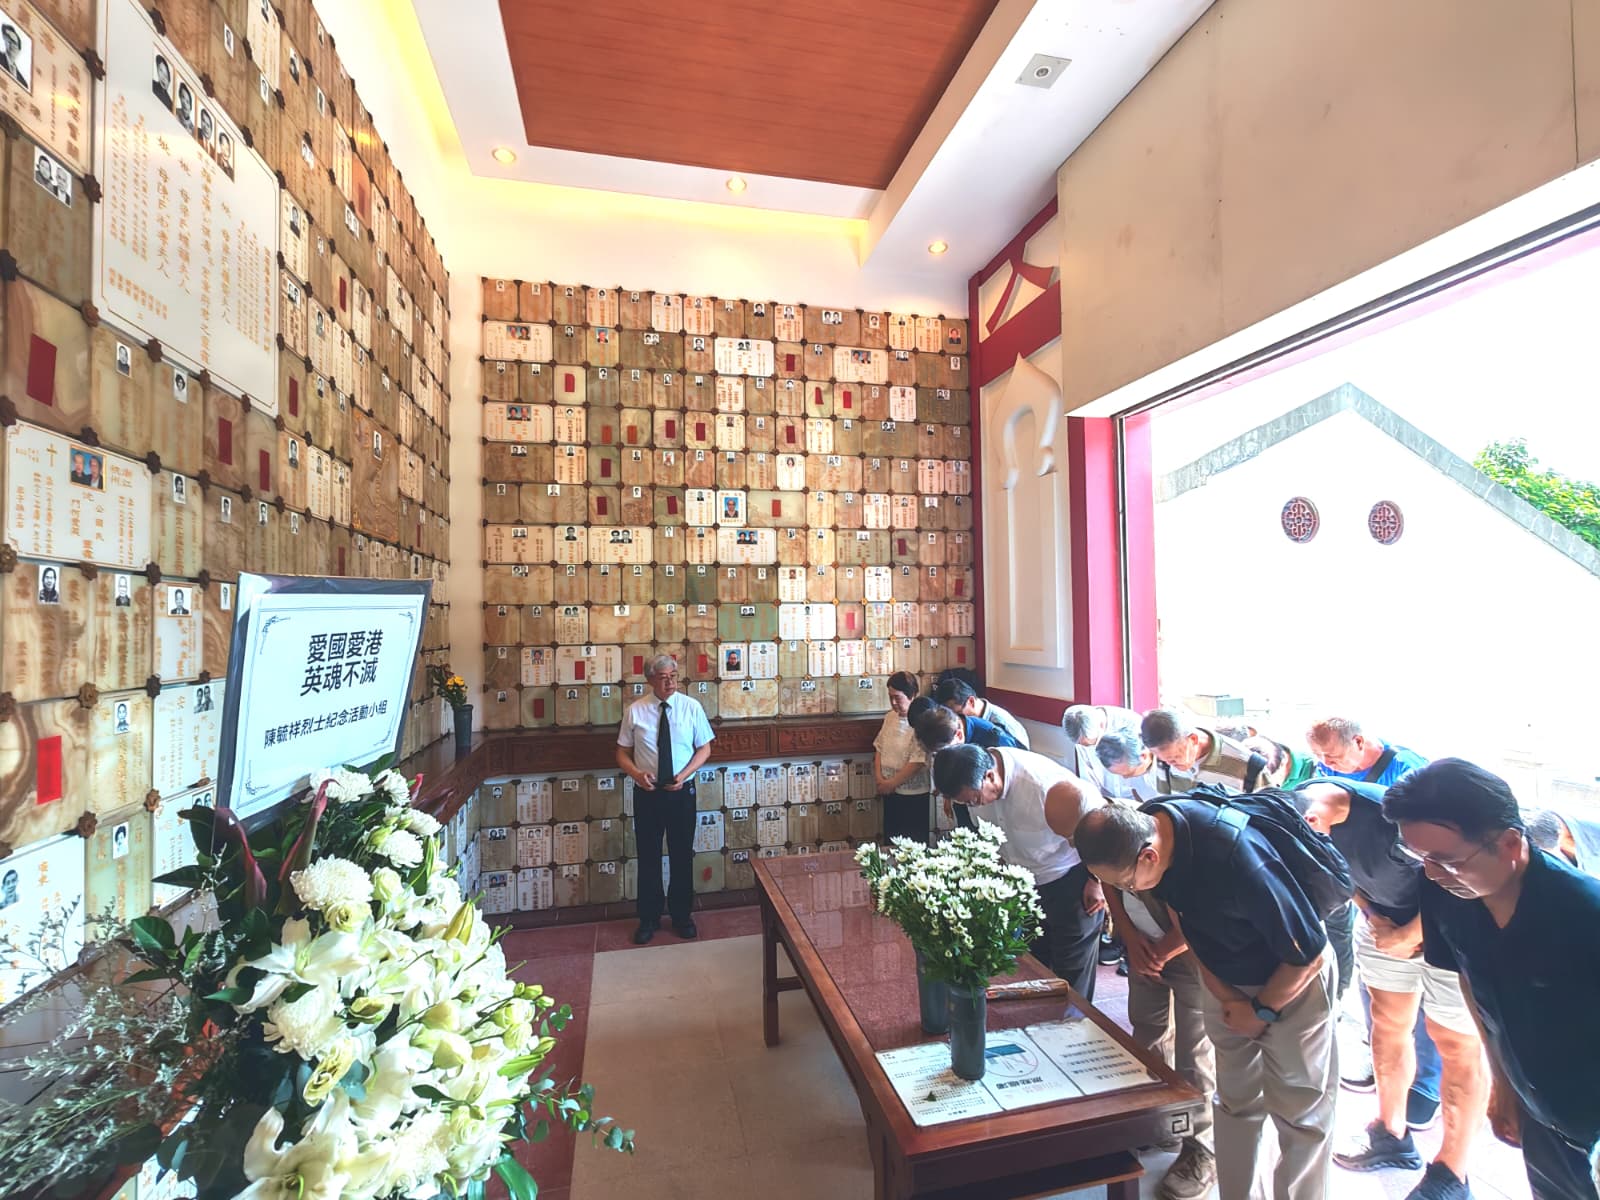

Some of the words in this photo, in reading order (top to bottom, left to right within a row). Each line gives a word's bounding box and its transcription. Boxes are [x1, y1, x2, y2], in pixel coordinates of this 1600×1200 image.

[307, 629, 383, 664] 愛國愛港
[300, 657, 379, 696] 英魂不滅
[264, 700, 388, 749] 陳毓祥烈士紀念活動小組
